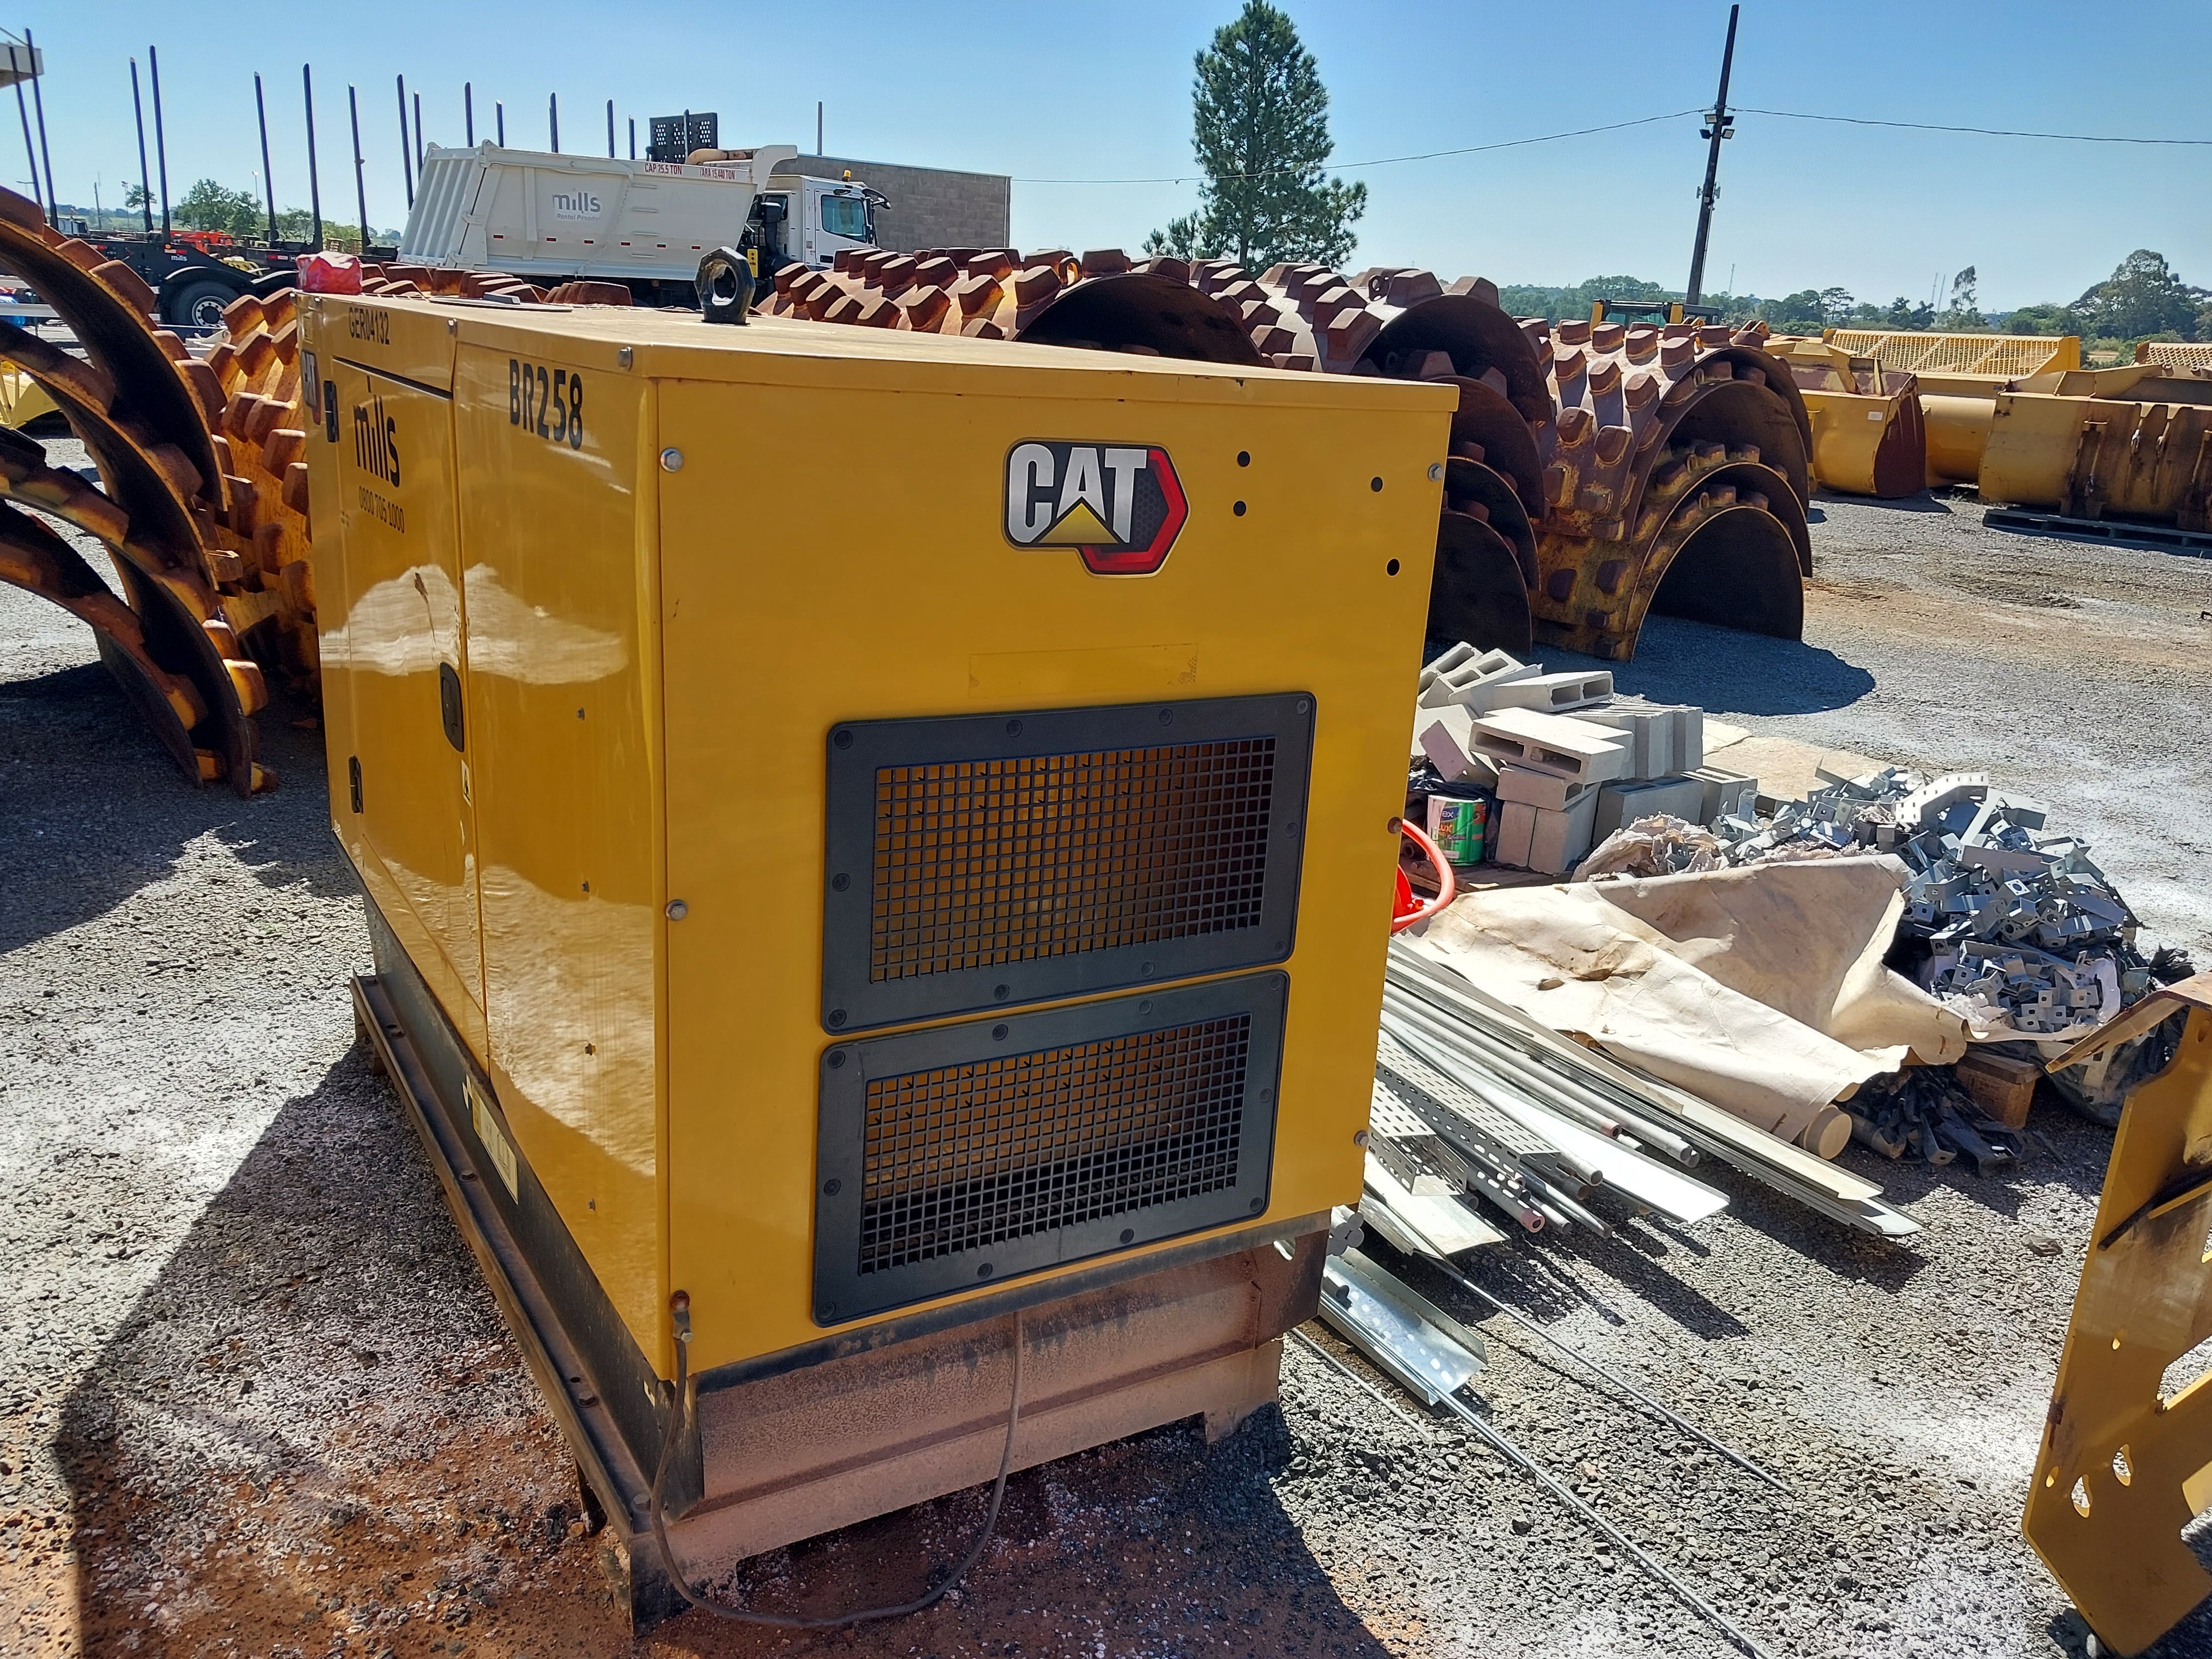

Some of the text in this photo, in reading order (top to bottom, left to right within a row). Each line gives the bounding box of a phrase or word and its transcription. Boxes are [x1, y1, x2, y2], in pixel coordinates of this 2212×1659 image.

[645, 163, 656, 173] CAP
[671, 166, 682, 175] TON
[726, 171, 735, 180] TON
[552, 188, 601, 212] mills
[349, 306, 389, 344] GER04132
[509, 359, 582, 450] BR258
[353, 375, 400, 488] mills
[359, 486, 404, 534] 0800 705 1000
[1008, 444, 1147, 543] CAT
